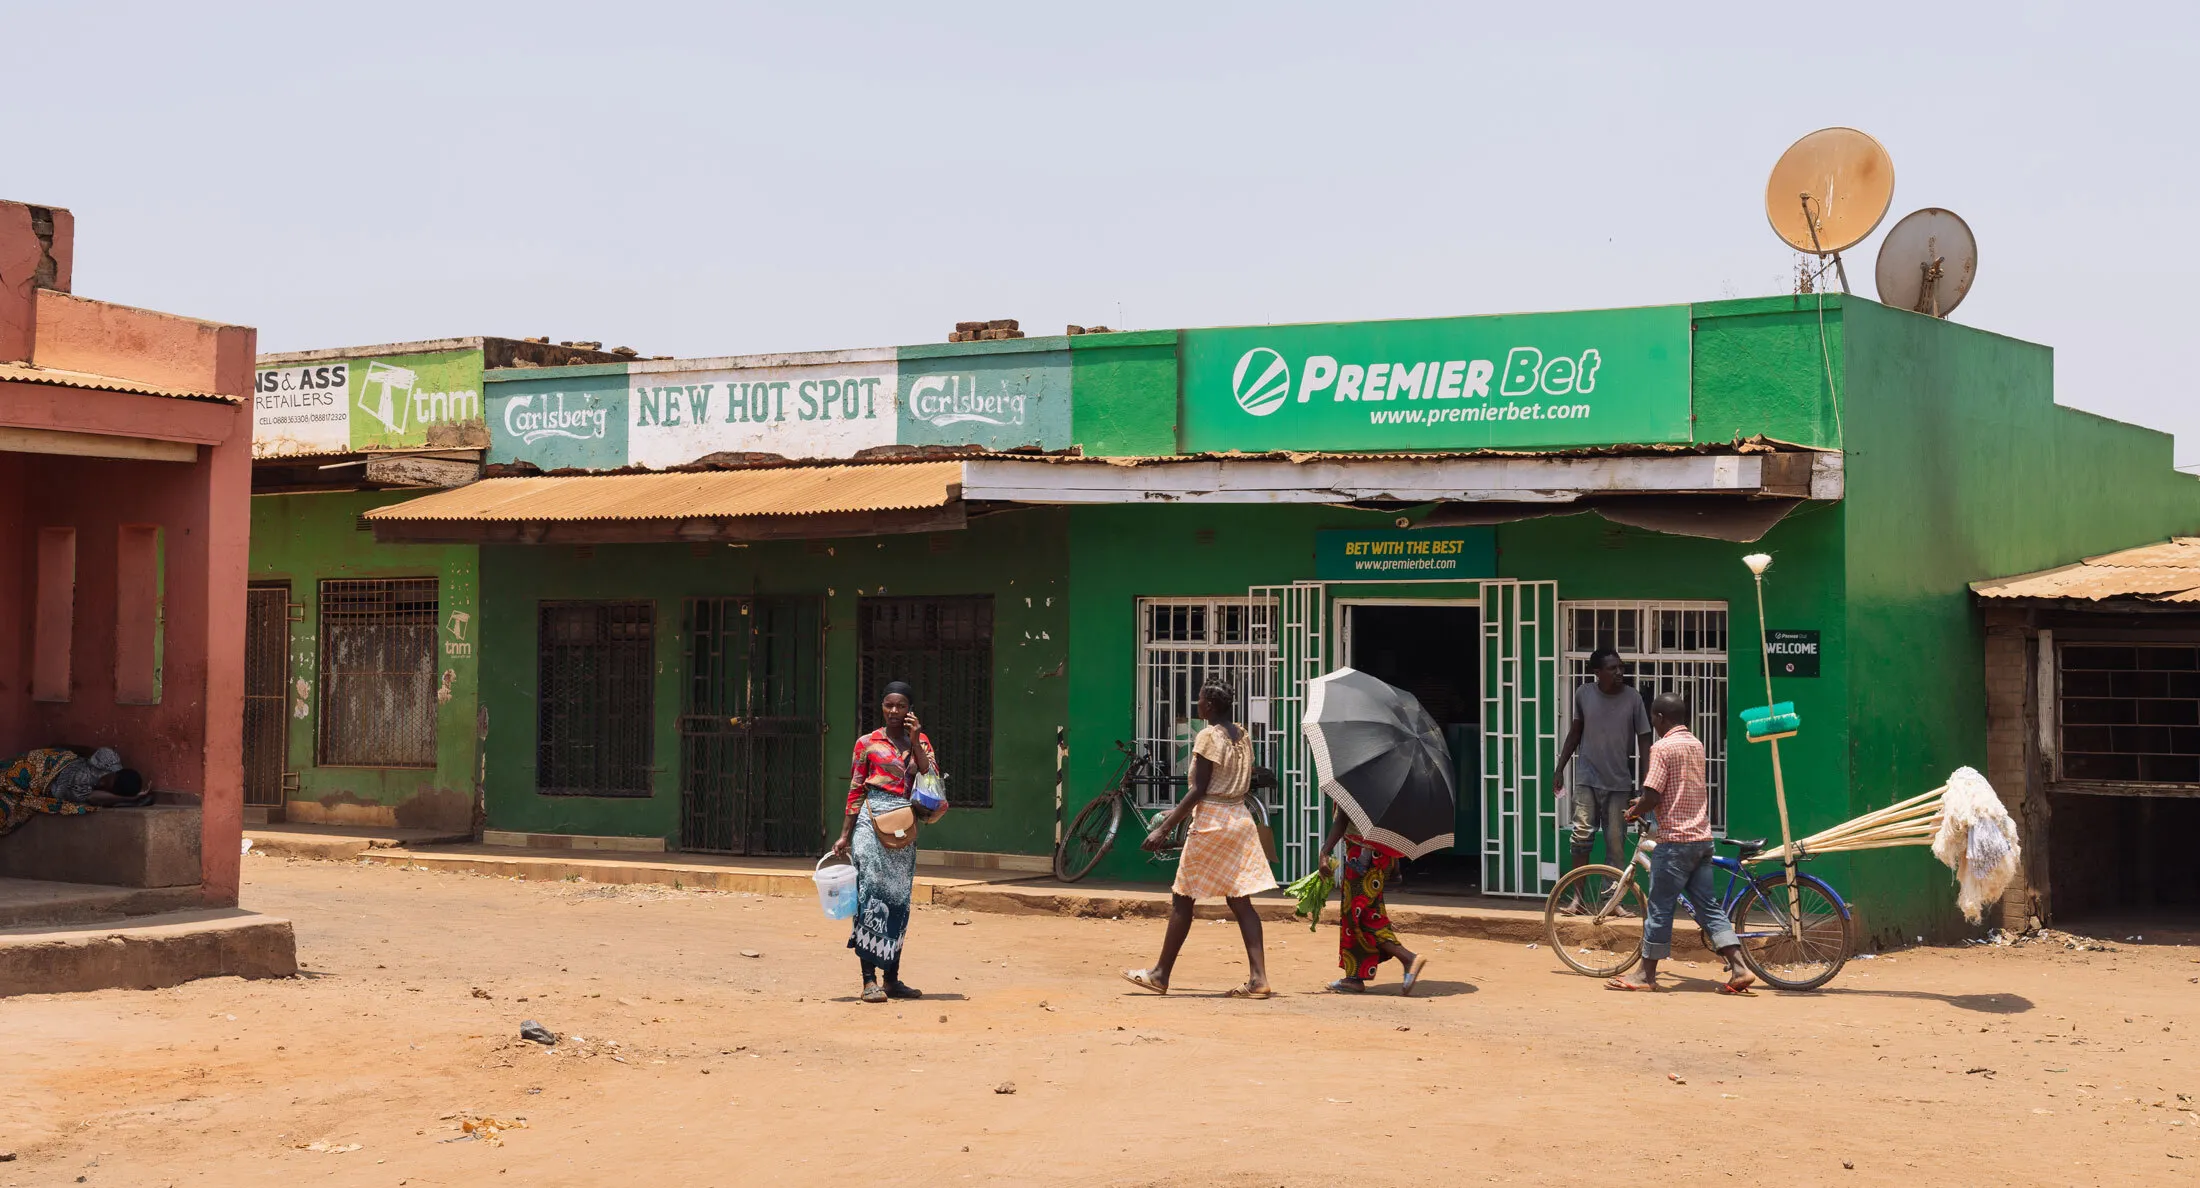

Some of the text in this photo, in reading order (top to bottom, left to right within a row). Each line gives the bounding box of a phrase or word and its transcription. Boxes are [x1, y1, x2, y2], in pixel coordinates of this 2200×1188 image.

[281, 372, 296, 391] &
[299, 366, 346, 390] ASS
[1298, 347, 1601, 403] PREMIER Bet
[256, 391, 334, 410] RETAILERS
[413, 388, 478, 423] tnm
[637, 378, 881, 427] NEW HOT SPOT
[909, 375, 1027, 427] Carlsberg
[504, 392, 607, 445] Carlsberg
[1370, 401, 1590, 427] www.premierbet.com
[1345, 540, 1465, 555] BET WITH THE BEST
[1355, 558, 1456, 571] www.premierbet.com
[445, 640, 471, 655] tnm
[1765, 642, 1817, 655] WELCOME
